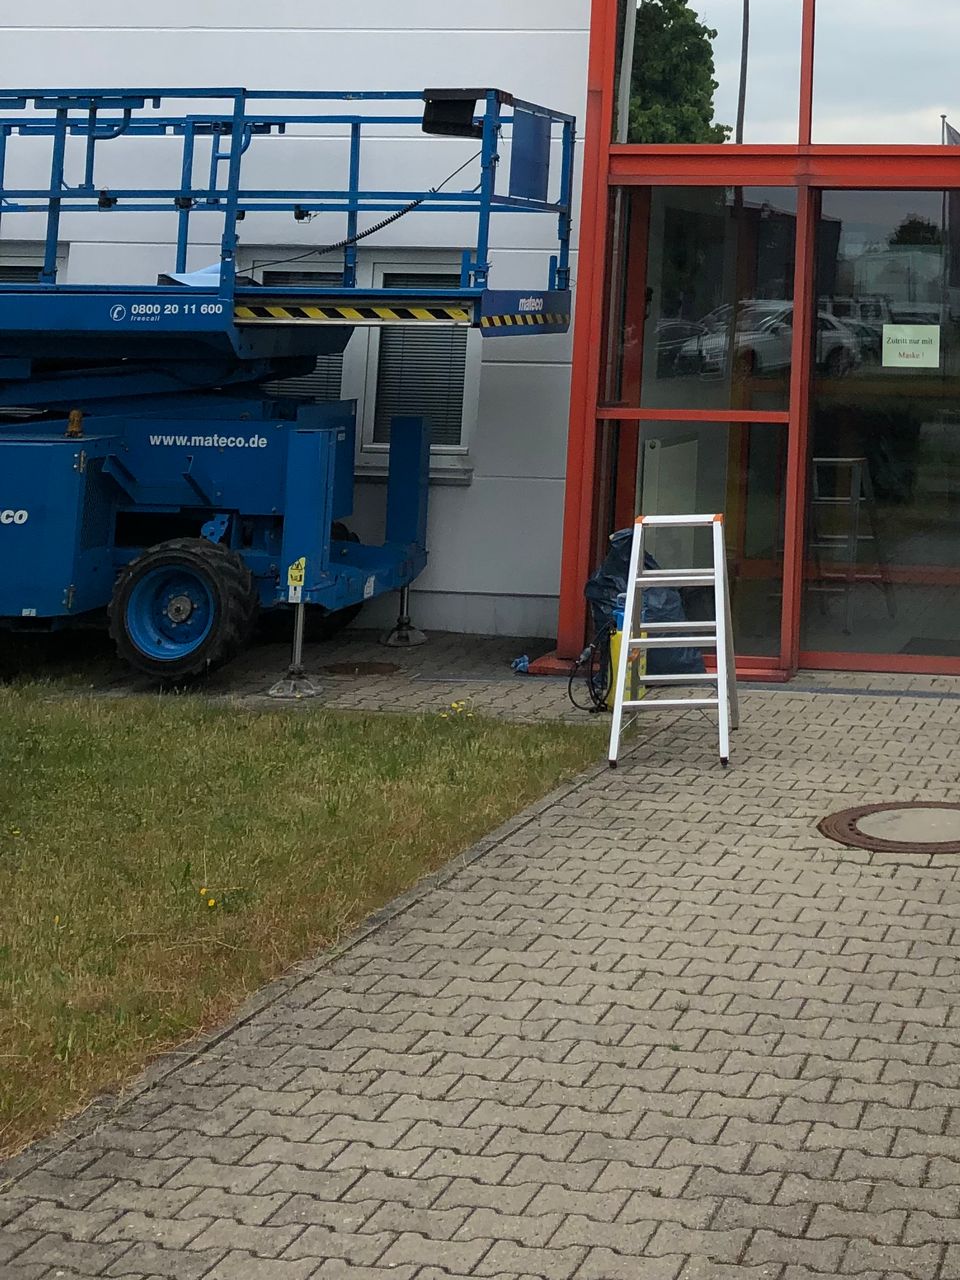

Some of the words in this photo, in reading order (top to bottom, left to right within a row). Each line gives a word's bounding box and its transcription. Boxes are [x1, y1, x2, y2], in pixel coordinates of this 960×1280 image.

[131, 304, 161, 314] 0800
[163, 304, 179, 314] 20
[183, 304, 196, 314] 11
[200, 304, 223, 314] 600
[518, 296, 543, 311] mateco
[149, 434, 268, 448] www.mateco.de
[0, 509, 29, 525] co
